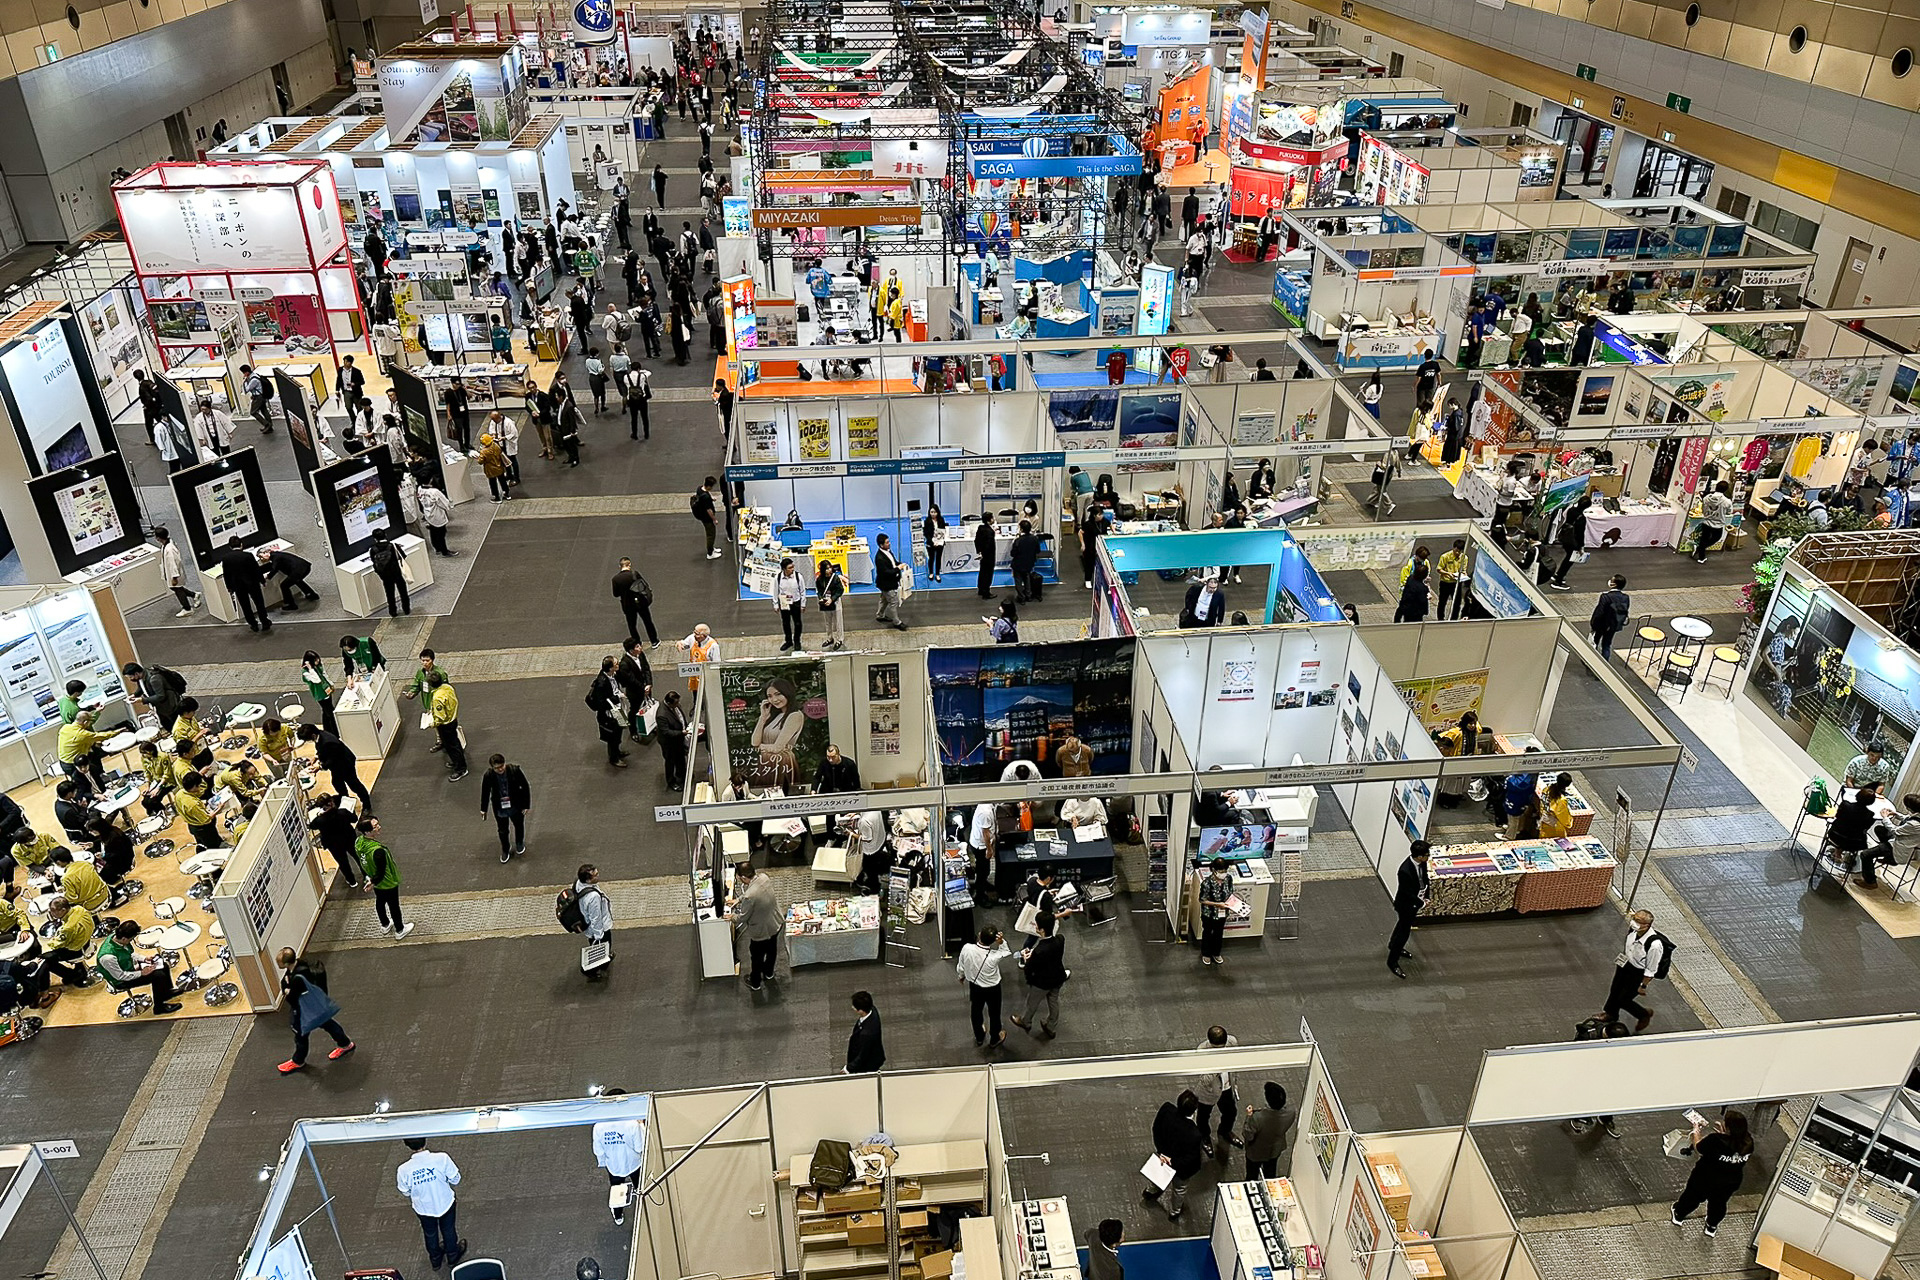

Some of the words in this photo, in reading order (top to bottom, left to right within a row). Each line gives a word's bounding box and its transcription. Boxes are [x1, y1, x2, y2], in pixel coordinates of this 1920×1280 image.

[380, 64, 440, 76] Countryside
[383, 77, 405, 88] Stay
[1279, 151, 1305, 160] FUKUOKA
[980, 163, 1014, 175] SAGA
[1077, 165, 1091, 173] This
[1093, 165, 1100, 173] is
[1101, 165, 1112, 173] the
[1114, 164, 1135, 172] SAGA
[759, 212, 819, 224] MIYAZAKI
[902, 214, 916, 223] Trip
[228, 198, 252, 259] ニッポンの
[1174, 356, 1186, 368] 39
[43, 358, 72, 386] TOURISM
[789, 465, 836, 473] ポケトーク株式会社
[721, 670, 762, 692] 旅色
[732, 754, 783, 767] わたしの
[749, 764, 792, 777] スタイル
[1040, 782, 1116, 792] 全国工場夜景都市協議会
[770, 799, 860, 810] 株式会社ブランジスタメディア
[42, 1146, 71, 1154] 5-007
